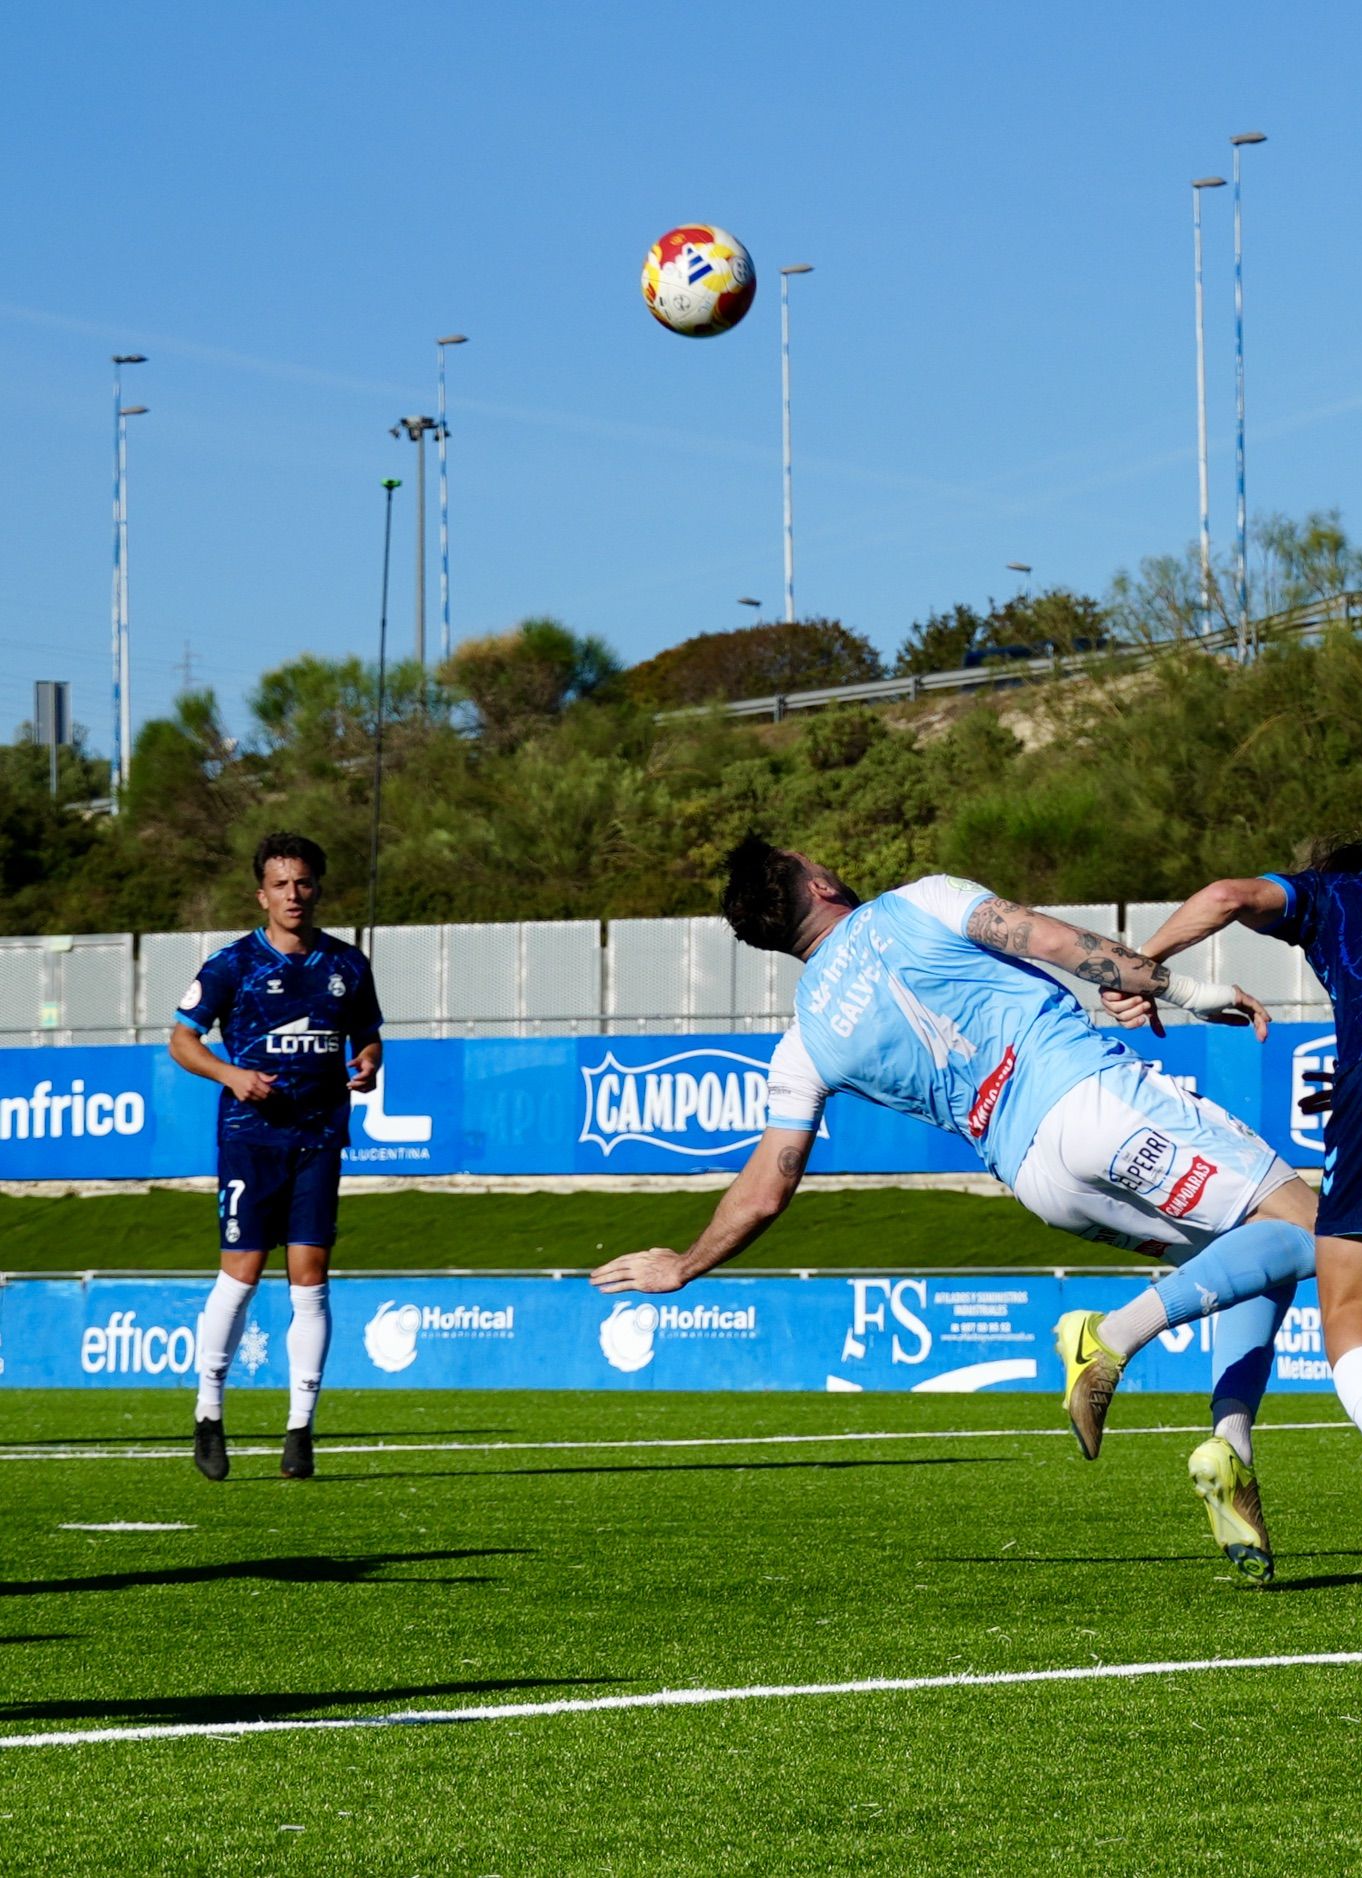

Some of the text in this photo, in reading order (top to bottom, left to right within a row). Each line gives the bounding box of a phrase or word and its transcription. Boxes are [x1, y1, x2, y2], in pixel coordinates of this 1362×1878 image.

[266, 1034, 340, 1054] LOTUS
[349, 1147, 431, 1162] LUCENTINA
[227, 1179, 246, 1216] 7
[1165, 1163, 1210, 1217] CAMPOARAS
[422, 1305, 514, 1330] Hofrical
[660, 1305, 755, 1330] Hofrical
[847, 1278, 932, 1364] FS
